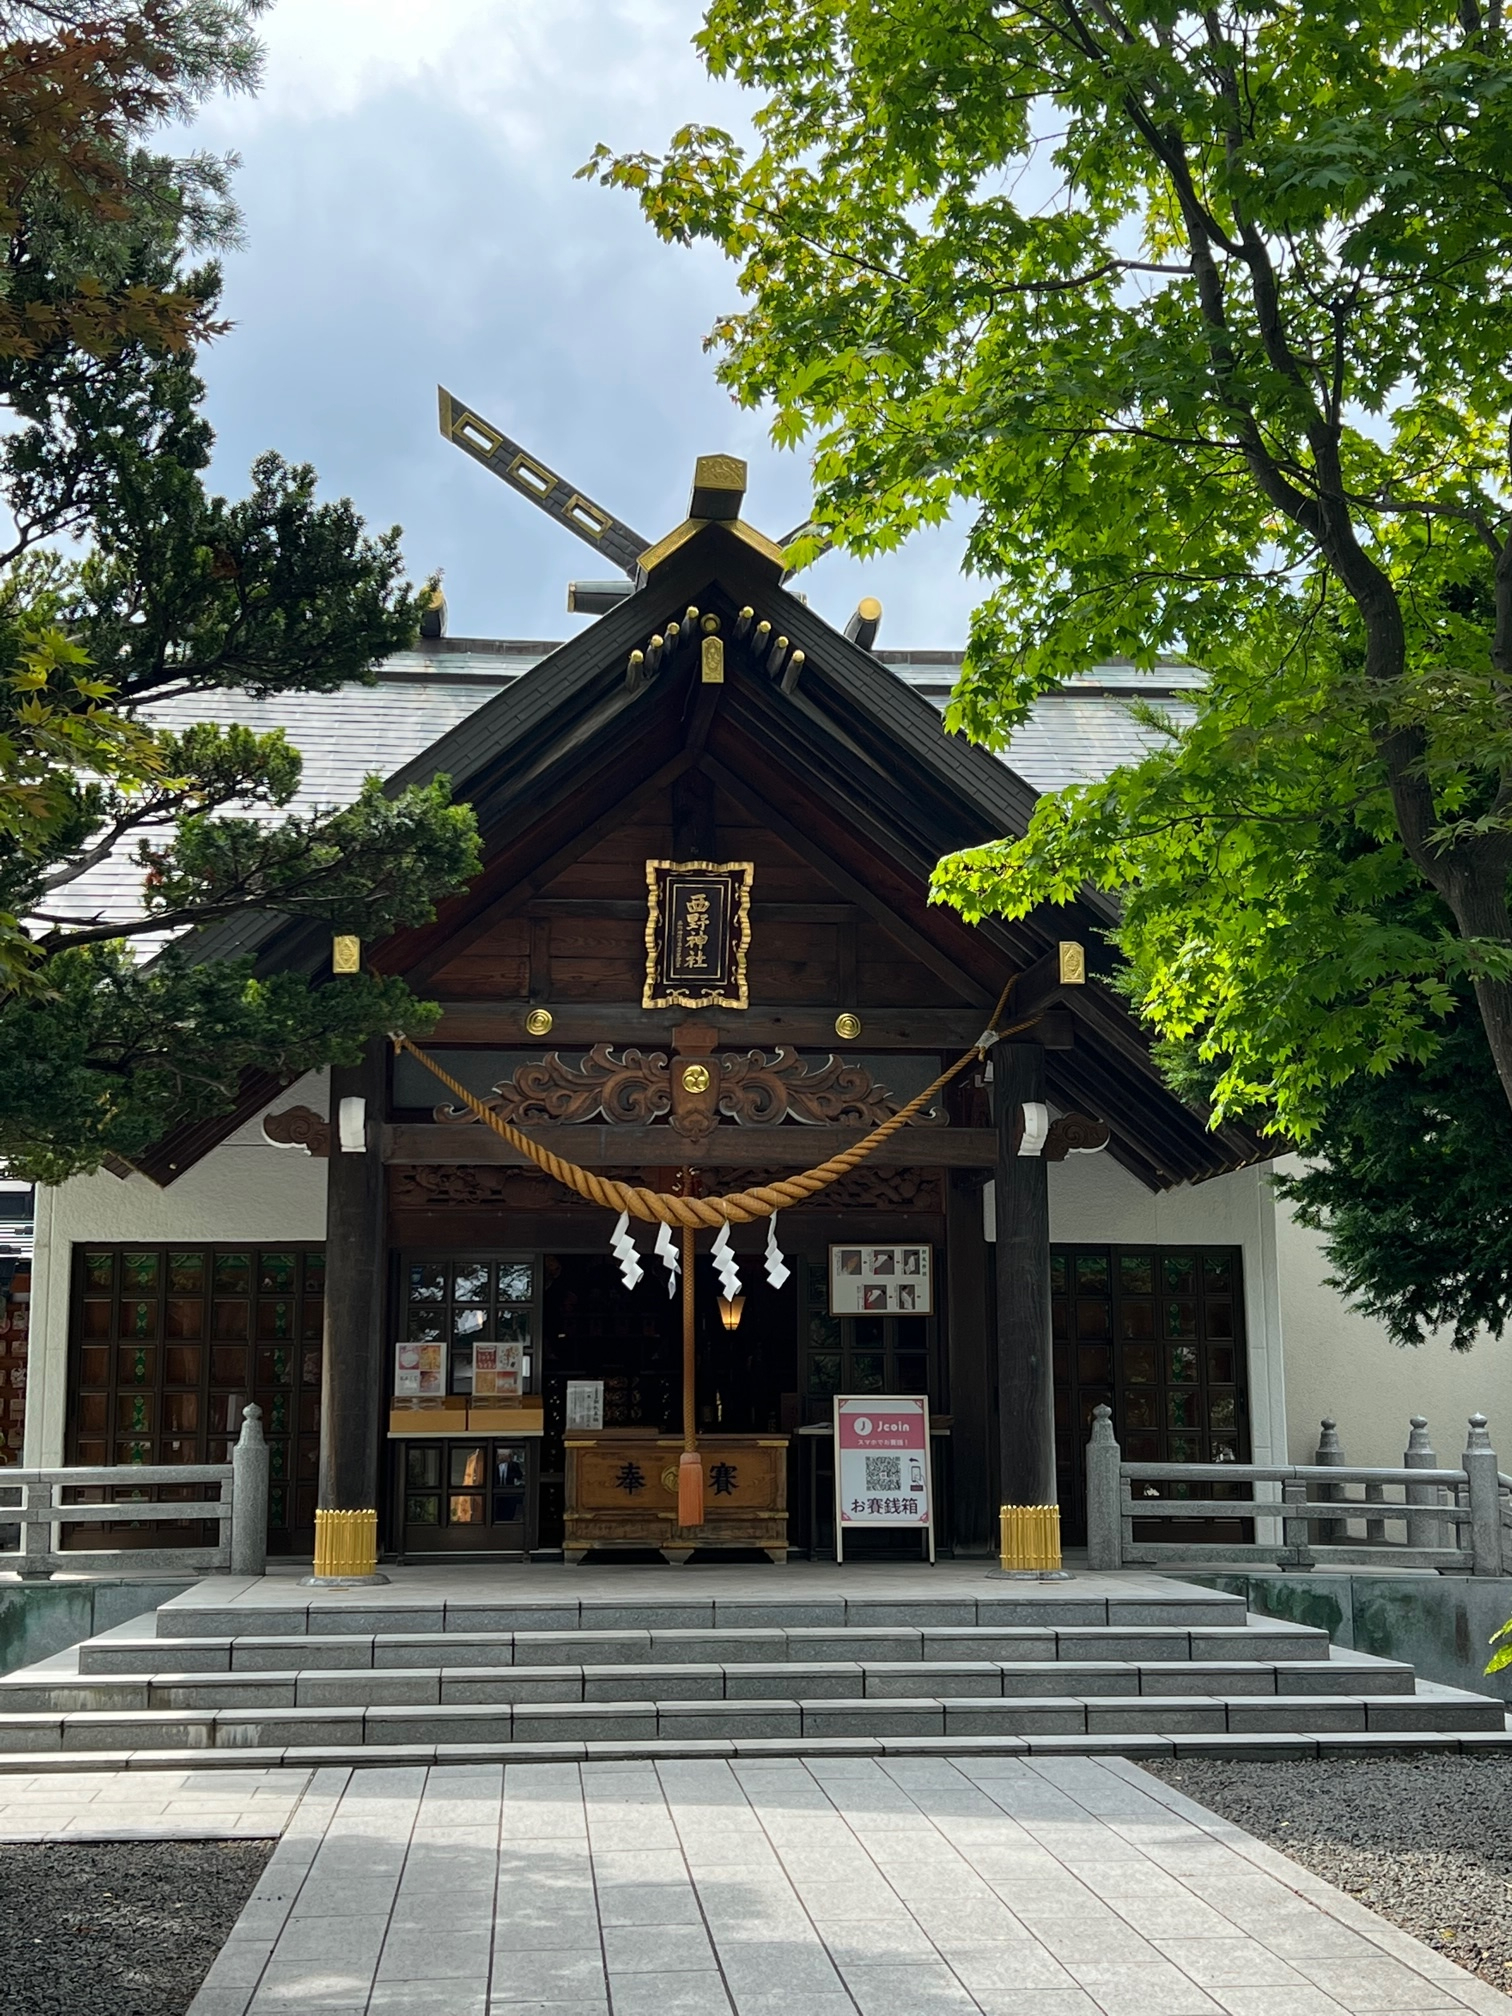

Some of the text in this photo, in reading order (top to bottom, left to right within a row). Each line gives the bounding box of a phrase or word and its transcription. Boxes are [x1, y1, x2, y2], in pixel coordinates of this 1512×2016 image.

[684, 893, 710, 969] 西野神社
[877, 1421, 910, 1432] Jcoin
[615, 1462, 740, 1496] 奉 賽
[851, 1498, 918, 1515] お賽銭箱
